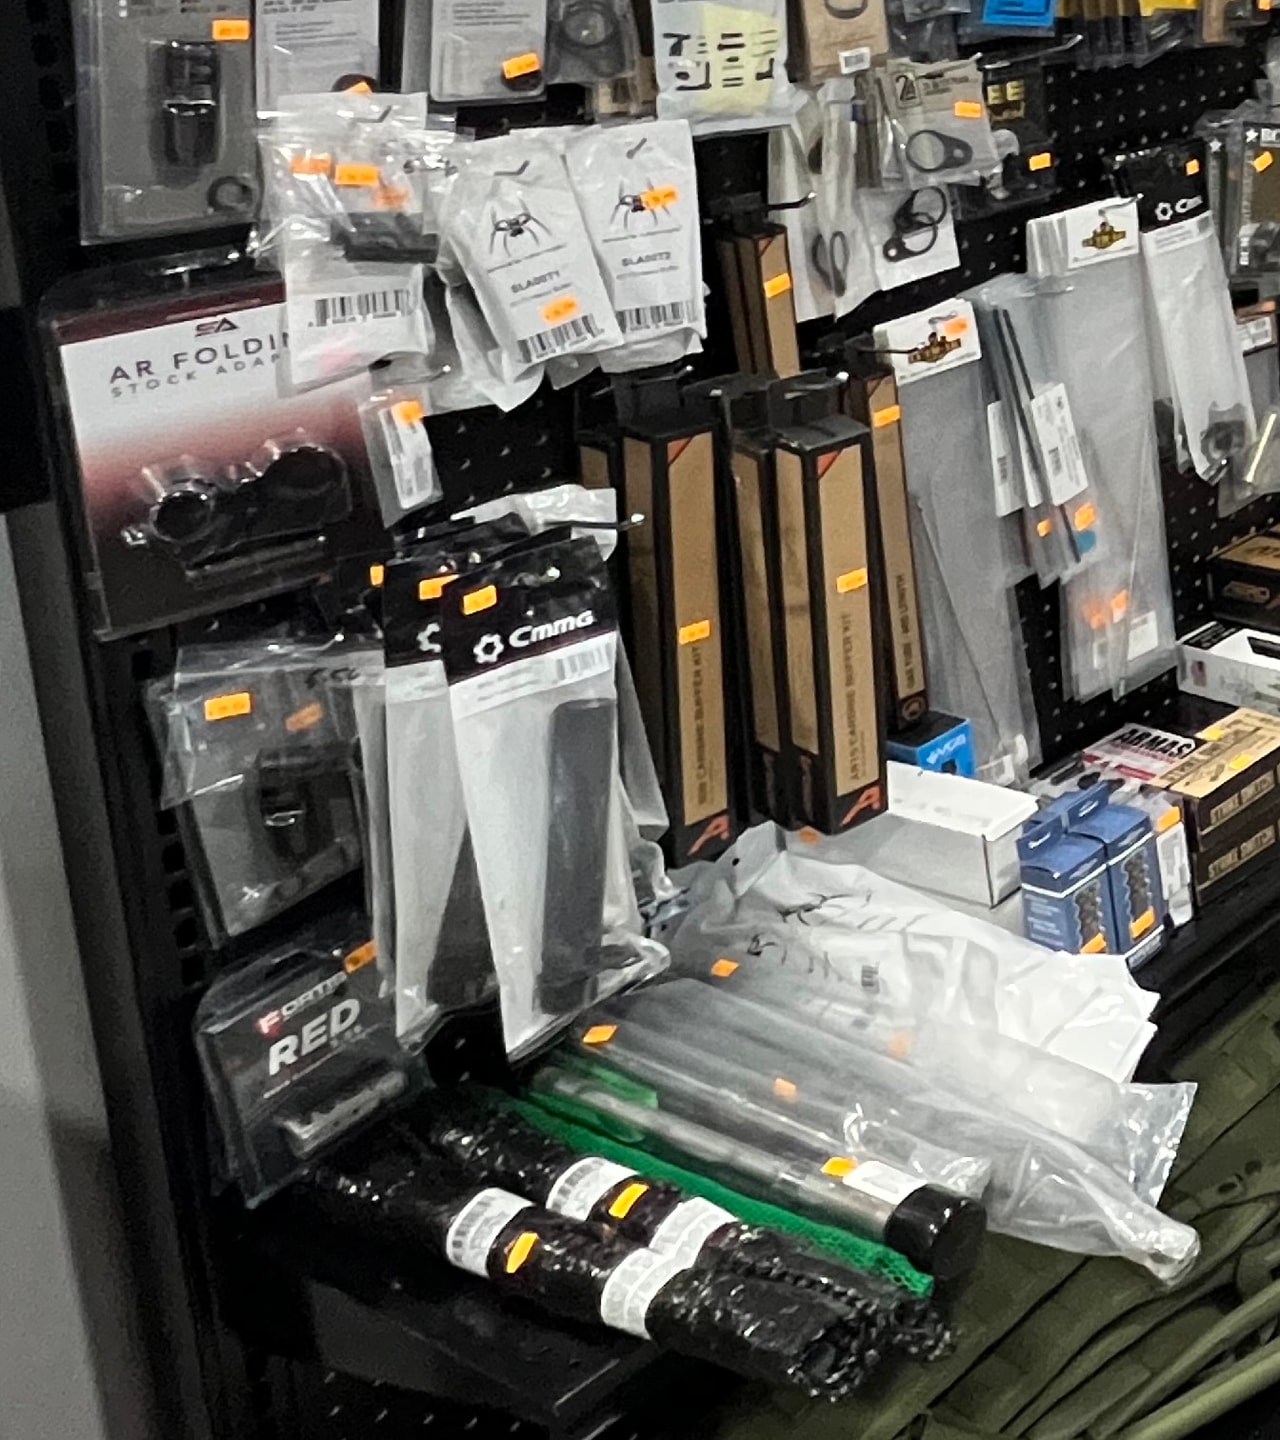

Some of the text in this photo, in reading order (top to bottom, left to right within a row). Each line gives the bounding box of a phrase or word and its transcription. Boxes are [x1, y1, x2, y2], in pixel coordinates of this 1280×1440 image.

[110, 360, 154, 384] AR
[111, 370, 197, 398] STOCK
[269, 998, 360, 1076] RED
